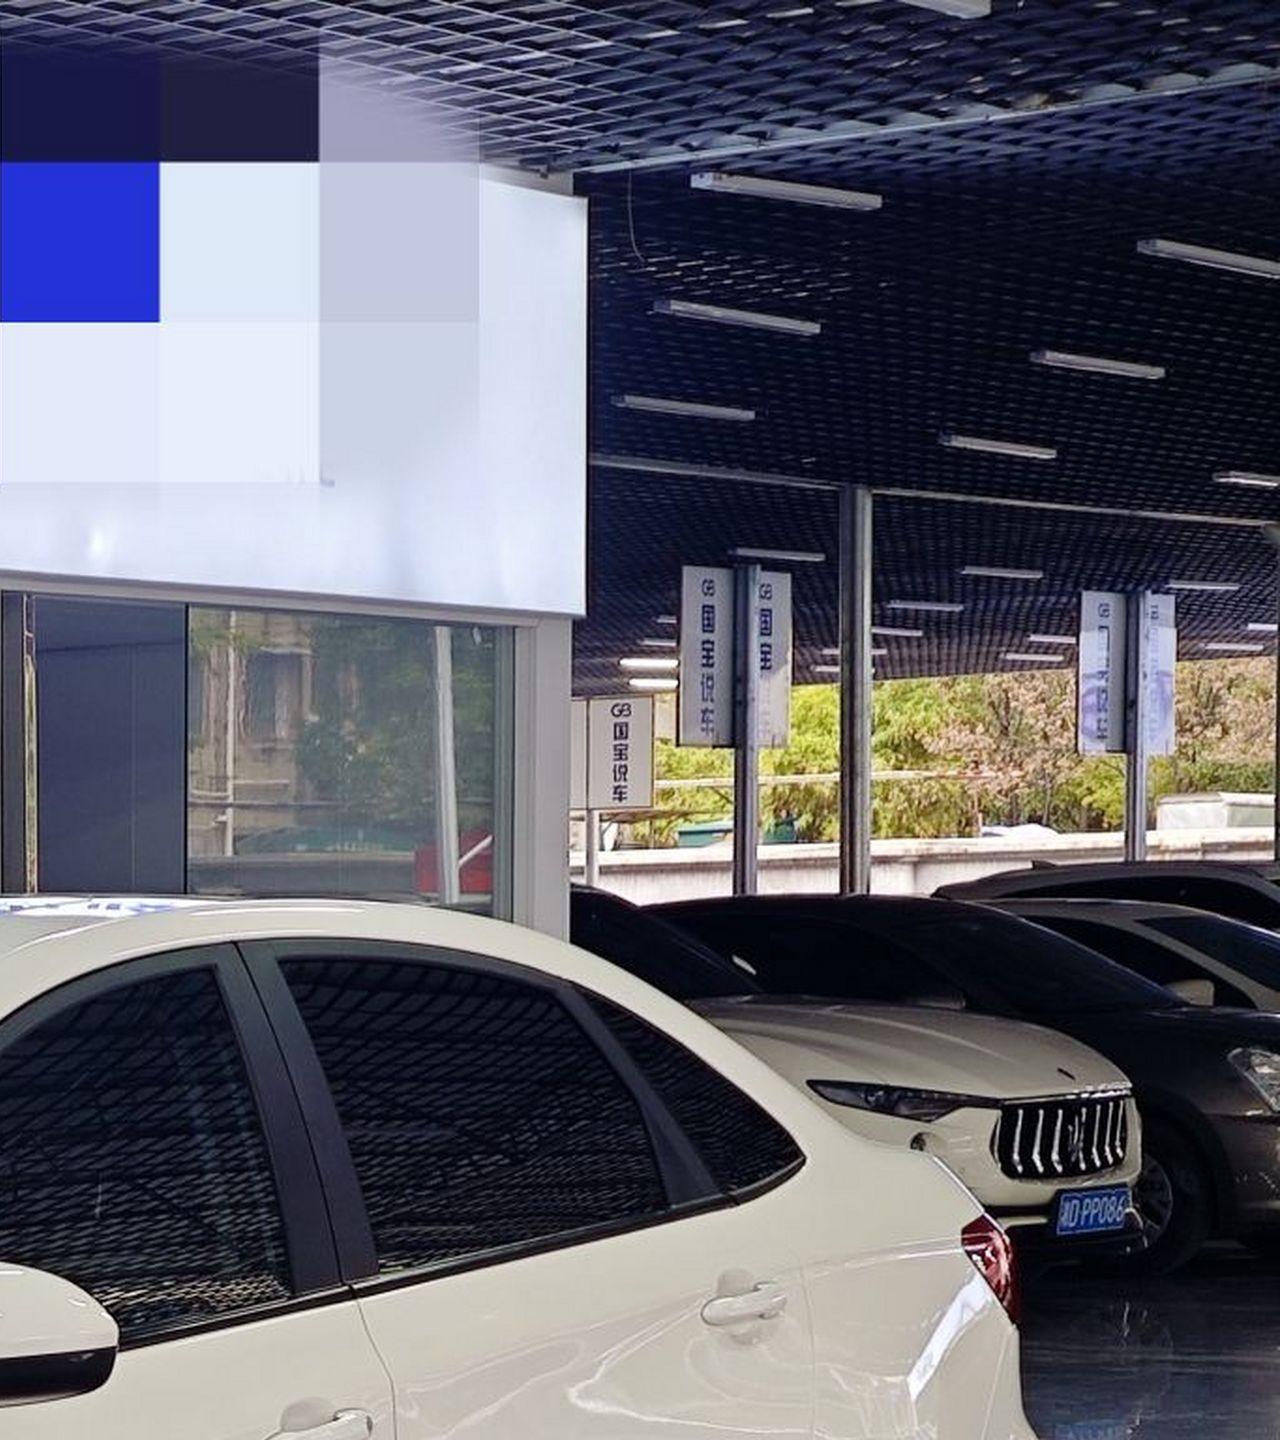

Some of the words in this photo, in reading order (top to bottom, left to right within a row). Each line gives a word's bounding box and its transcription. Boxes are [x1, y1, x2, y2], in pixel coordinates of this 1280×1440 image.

[700, 604, 716, 736] 国宝说车
[612, 721, 630, 803] 国宝说车
